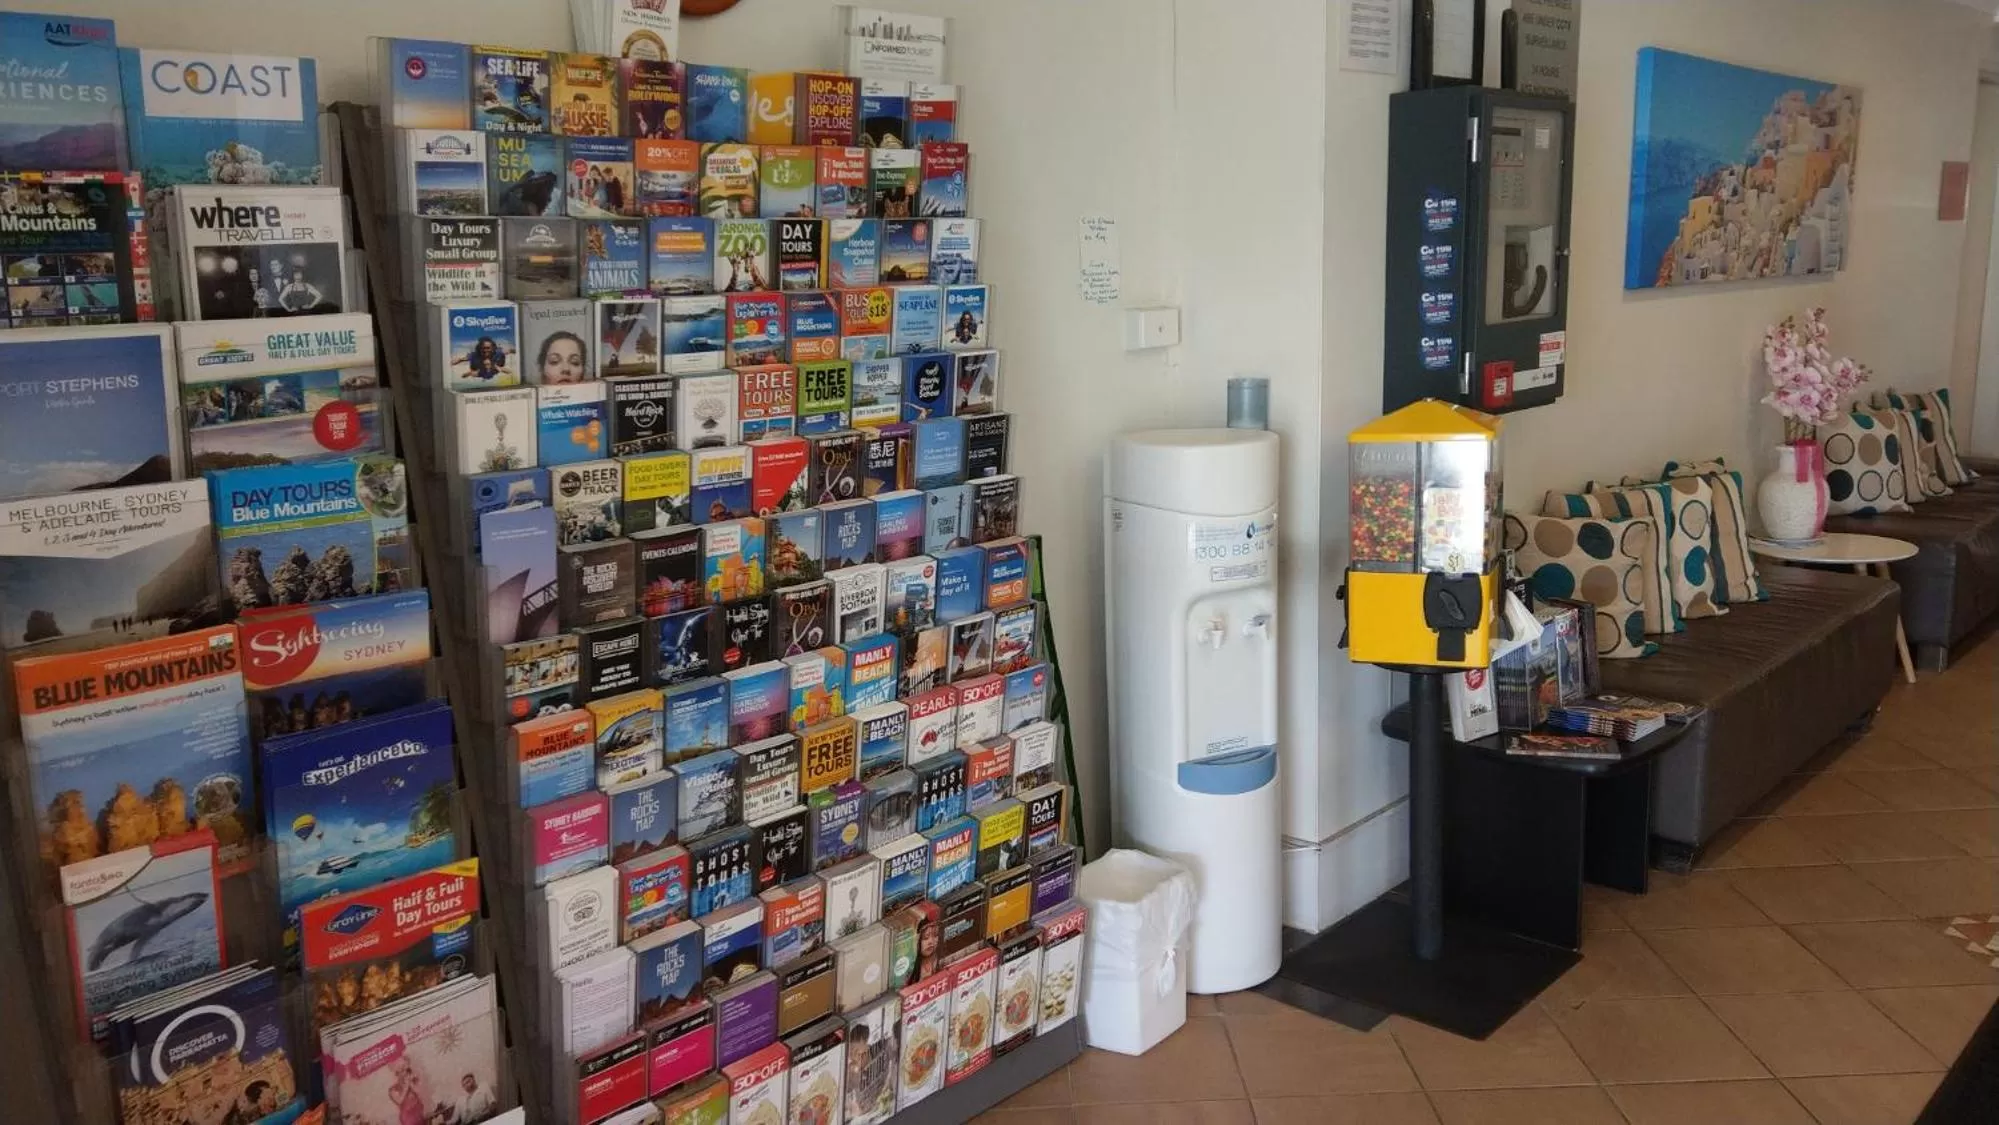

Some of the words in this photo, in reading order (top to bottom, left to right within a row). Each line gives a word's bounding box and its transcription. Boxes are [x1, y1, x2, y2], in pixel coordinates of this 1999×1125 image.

[487, 58, 514, 75] SEA
[152, 60, 291, 98] COAST
[809, 79, 854, 94] HOP-ON
[809, 94, 854, 106] DISCOVER
[809, 105, 854, 117] HOP-OFF
[518, 122, 543, 135] Night
[808, 116, 853, 129] EXPLORE
[498, 138, 527, 151] MU
[499, 153, 532, 167] SEA
[48, 203, 57, 215] &
[190, 197, 282, 229] where
[0, 215, 97, 233] Mountains
[431, 223, 454, 236] Day
[459, 222, 491, 235] Tours
[782, 224, 812, 240] DAY
[214, 227, 314, 243] TRAVELLER
[442, 236, 482, 249] Luxury
[426, 249, 460, 262] Small
[461, 249, 497, 262] Group
[782, 241, 812, 253] TOURS
[428, 281, 447, 292] the
[452, 280, 476, 292] Wild
[590, 268, 640, 290] ANIMALS
[845, 294, 870, 309] BUS
[267, 333, 312, 351] GREAT
[315, 330, 357, 346] VALUE
[46, 374, 140, 394] STEPHENS
[744, 370, 794, 391] FREE
[806, 368, 846, 388] FREE
[744, 388, 793, 407] TOURS
[806, 386, 846, 404] TOURS
[869, 441, 895, 458] 悉尼
[582, 468, 618, 483] BEER
[124, 489, 188, 509] SYDNEY
[232, 488, 275, 509] DAY
[279, 479, 351, 503] TOURS
[582, 485, 618, 497] TRACK
[40, 510, 123, 532] ADELAIDE
[130, 502, 182, 519] TOURS
[232, 506, 271, 523] Blue
[273, 497, 357, 519] Mountains
[343, 640, 406, 662] SYDNEY
[855, 645, 893, 666] MANLY
[33, 677, 99, 710] BLUE
[104, 649, 237, 697] MOUNTAINS
[855, 663, 892, 683] BEACH
[913, 692, 956, 717] PEARLS
[870, 713, 905, 732] MANLY
[543, 732, 569, 746] BLUE
[869, 726, 905, 743] BEACH
[526, 736, 586, 759] MOUNTAINS
[750, 752, 767, 766] Day
[767, 745, 795, 759] Tours
[807, 738, 853, 768] FREE
[807, 755, 852, 778] TOURS
[922, 768, 964, 794] GHOST
[638, 788, 655, 802] THE
[922, 784, 964, 809] TOURS
[1032, 795, 1058, 815] DAY
[630, 801, 660, 821] ROCKS
[820, 800, 861, 823] SYDNEY
[1031, 810, 1057, 826] TOURS
[636, 819, 655, 834] MAP
[936, 829, 971, 852] MANLY
[697, 843, 751, 876] GHOST
[891, 846, 927, 868] MANLY
[891, 857, 927, 877] BEACH
[936, 845, 970, 869] BEACH
[697, 861, 751, 891] TOURS
[392, 888, 423, 913] Half
[425, 886, 438, 900] &
[439, 876, 466, 898] Full
[397, 908, 423, 928] Day
[425, 895, 463, 916] Tours
[664, 943, 679, 959] THE
[656, 954, 686, 977] ROCKS
[662, 970, 680, 988] MAP
[734, 1071, 761, 1092] 50%
[760, 1057, 786, 1080] OFF
